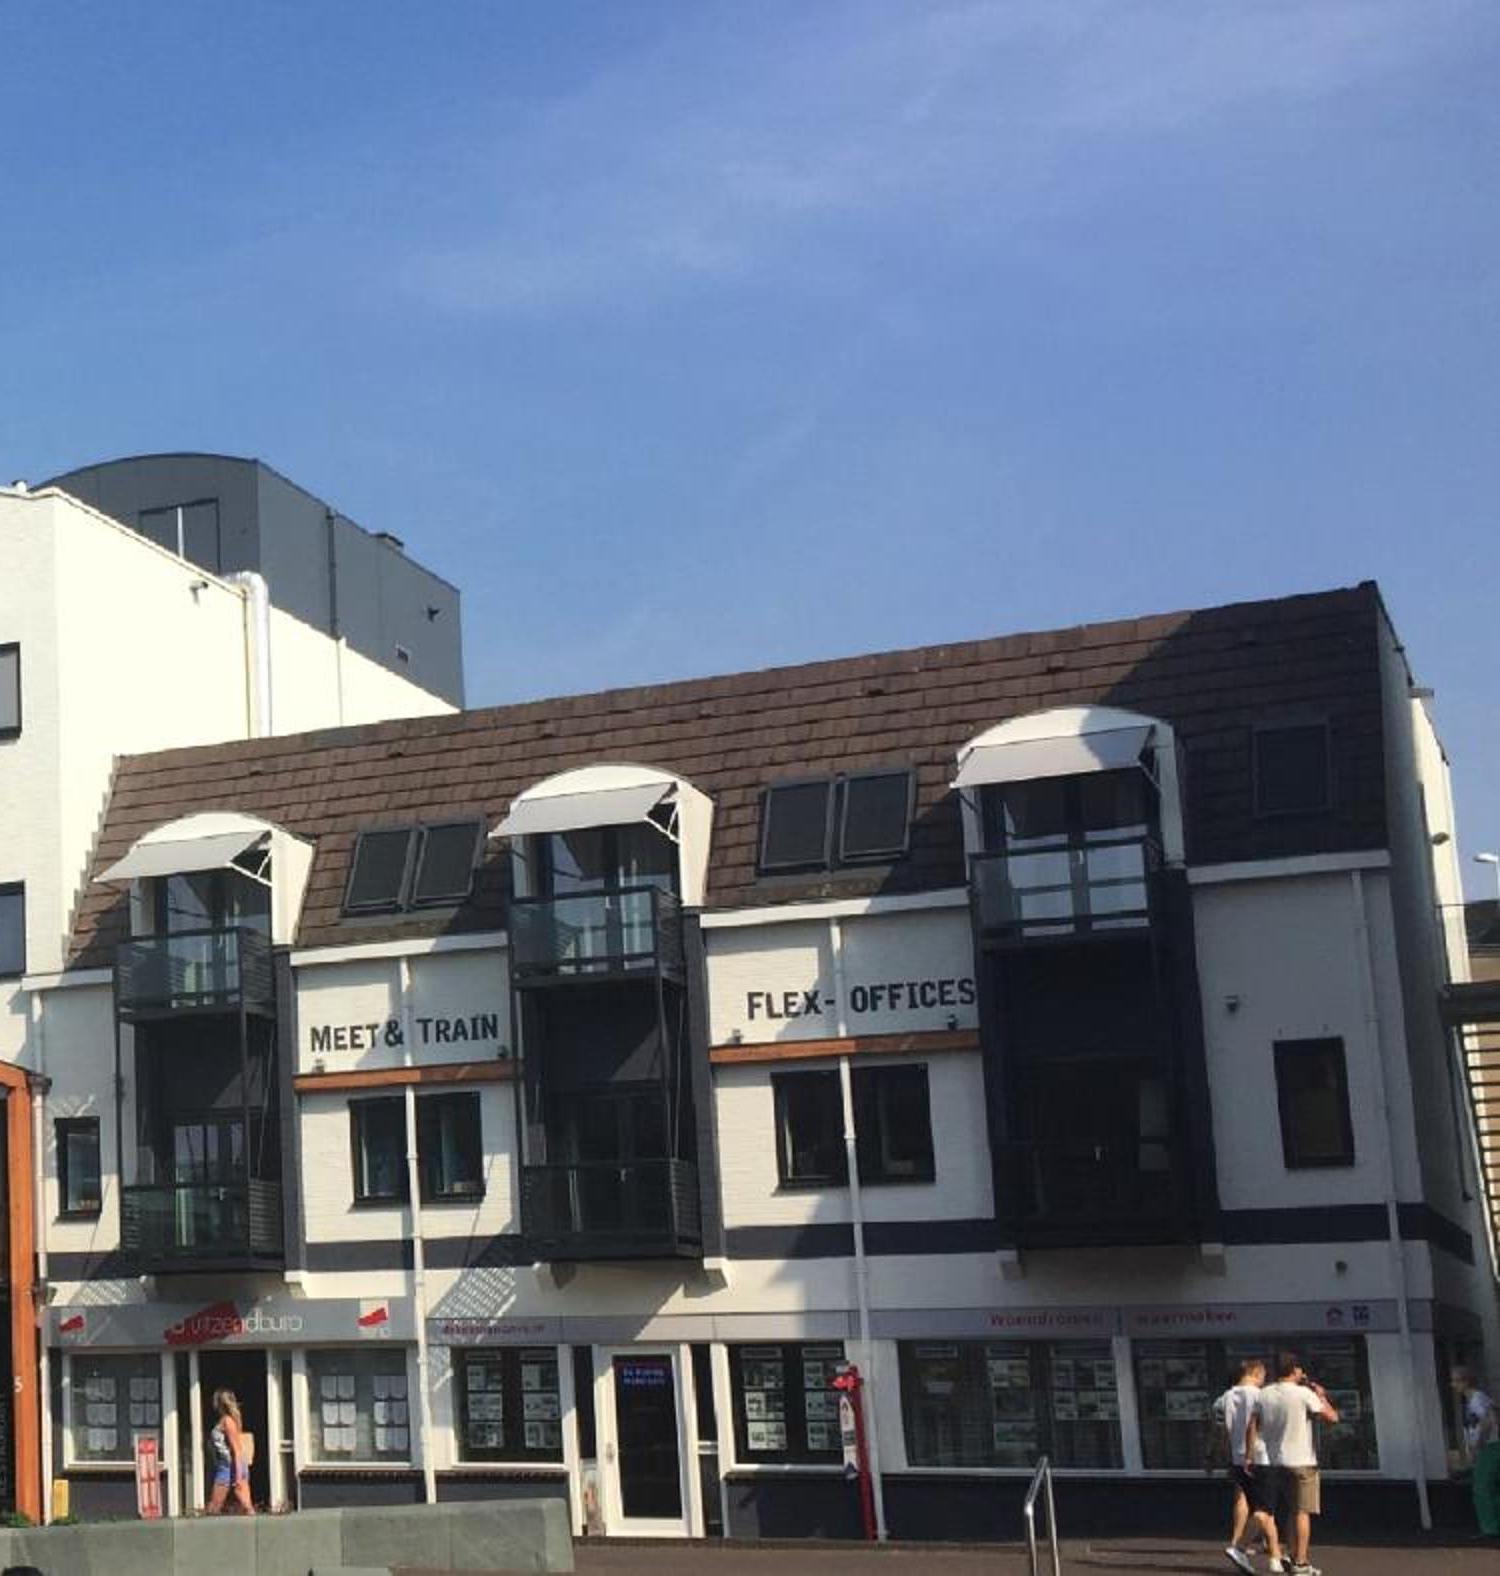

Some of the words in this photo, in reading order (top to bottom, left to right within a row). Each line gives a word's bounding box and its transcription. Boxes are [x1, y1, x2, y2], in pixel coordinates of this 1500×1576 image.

[850, 978, 977, 1013] OFFICES
[310, 1024, 379, 1052] MEET
[384, 1019, 404, 1047] &
[416, 1013, 499, 1043] TRAIN
